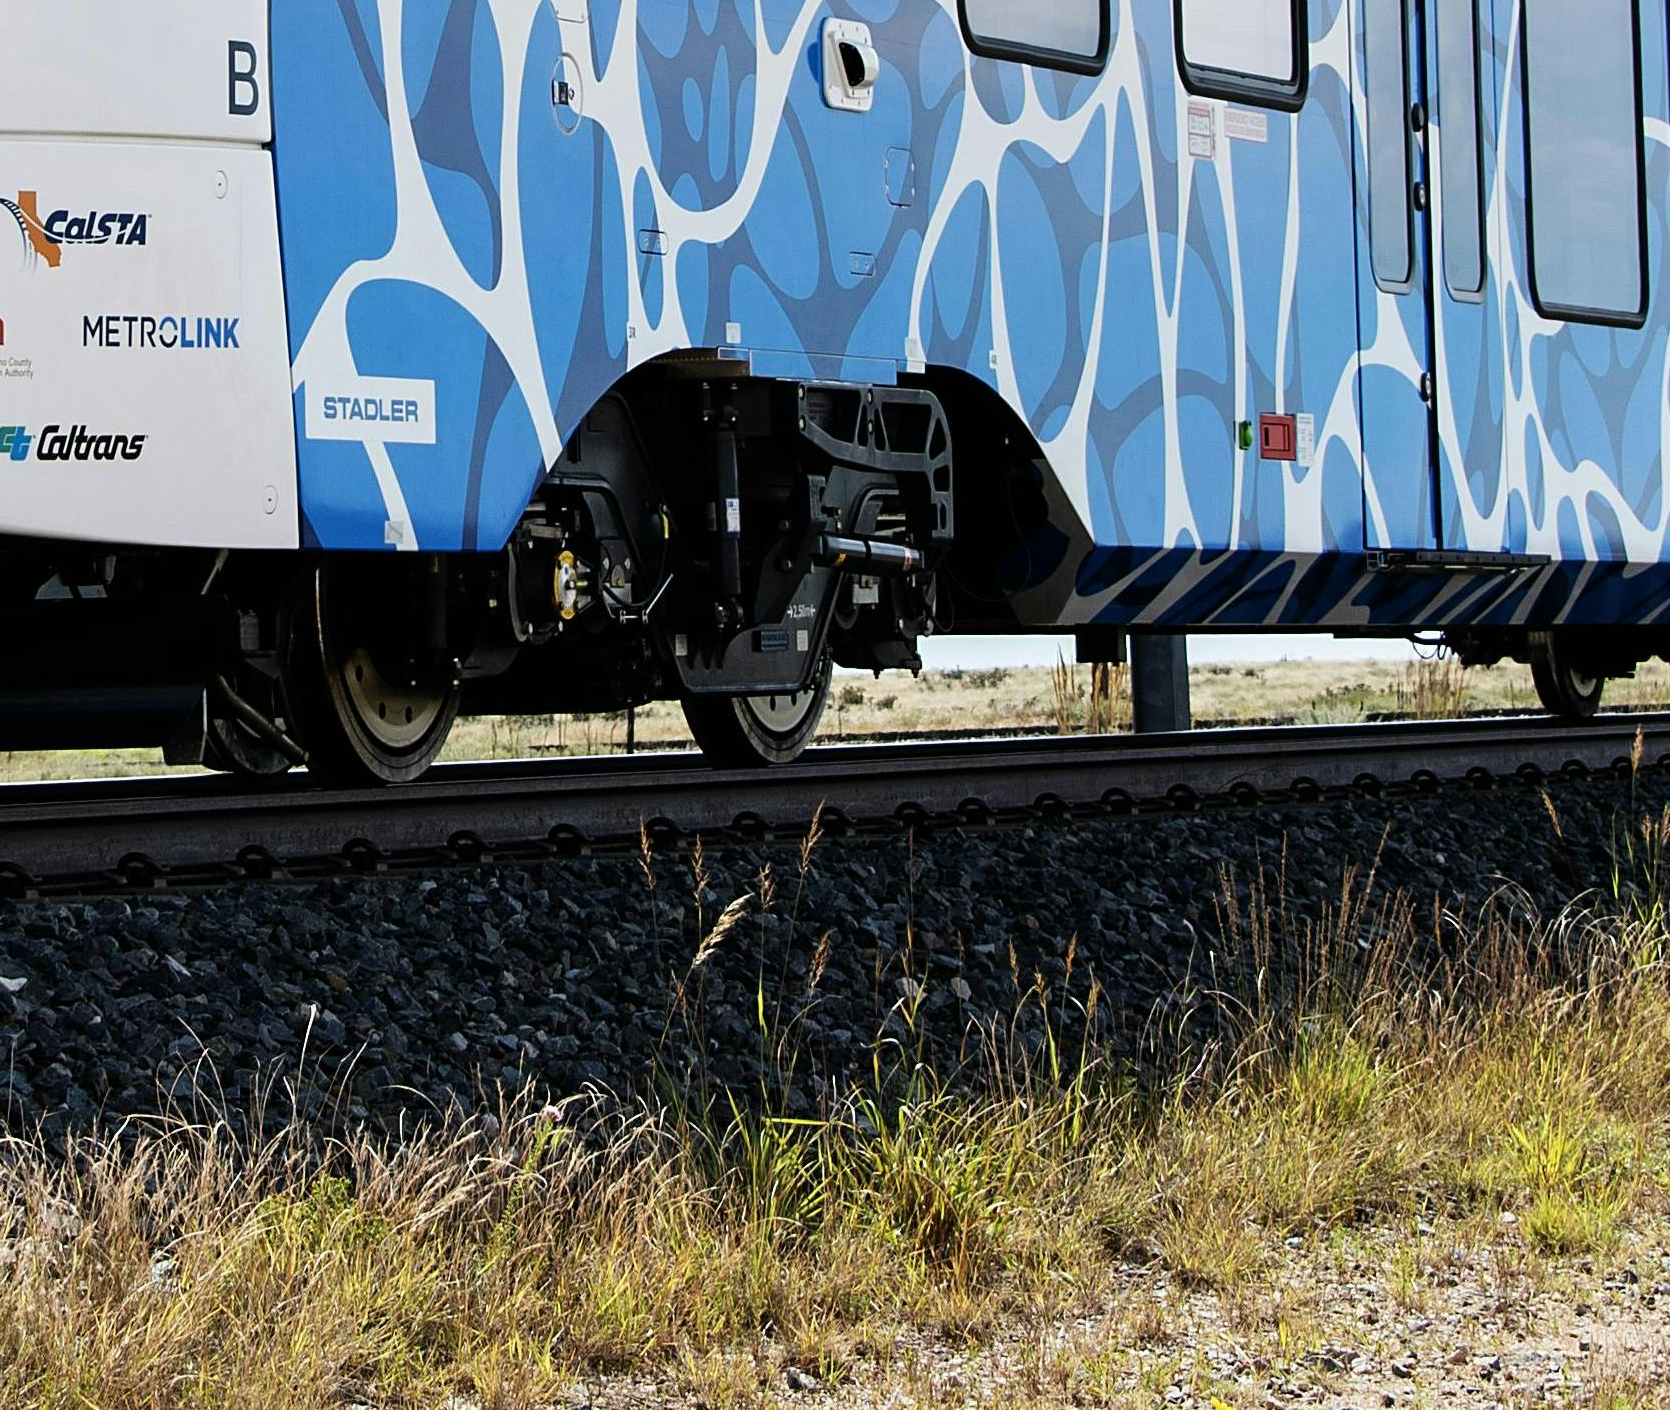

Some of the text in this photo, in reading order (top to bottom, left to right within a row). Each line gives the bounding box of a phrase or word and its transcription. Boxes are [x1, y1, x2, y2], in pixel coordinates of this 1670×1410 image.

[227, 39, 260, 116] B
[44, 209, 147, 246] CalSTA
[82, 315, 241, 349] METROLINK
[4, 368, 34, 379] Authority
[8, 357, 32, 368] County
[323, 396, 419, 423] STADLER
[36, 424, 147, 461] Caltrans
